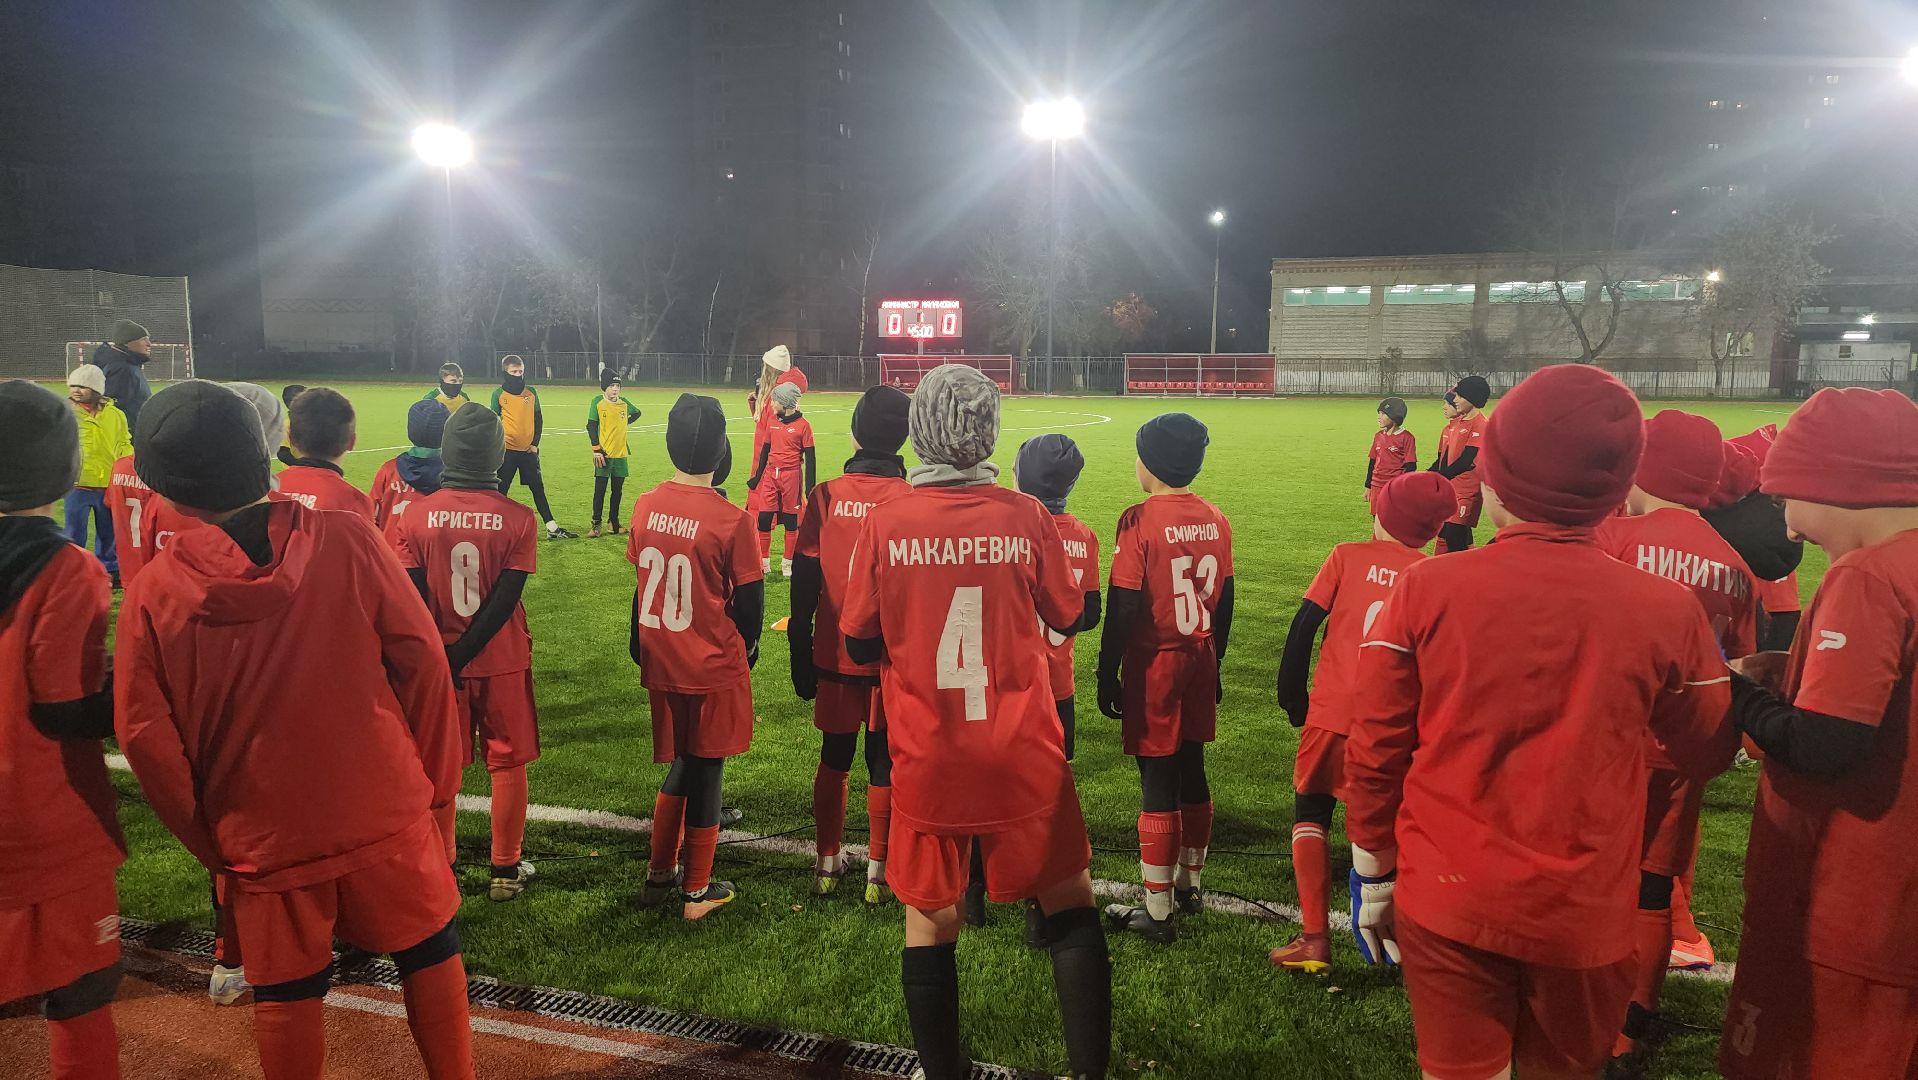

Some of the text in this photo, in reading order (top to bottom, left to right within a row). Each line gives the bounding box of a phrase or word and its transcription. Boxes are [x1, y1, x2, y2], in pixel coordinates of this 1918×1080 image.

[888, 313, 901, 335] 0
[942, 313, 956, 335] 0
[125, 497, 142, 548] 7
[427, 510, 503, 531] КРИСТЕВ
[646, 511, 700, 540] ИВКИН
[1164, 522, 1220, 544] СМИРНОВ
[888, 535, 1031, 567] МАКАРЕВИЧ
[450, 541, 481, 617] 8
[638, 546, 694, 633] 20
[1365, 564, 1399, 588] АСТ
[1170, 554, 1218, 636] 52
[936, 585, 989, 721] 4
